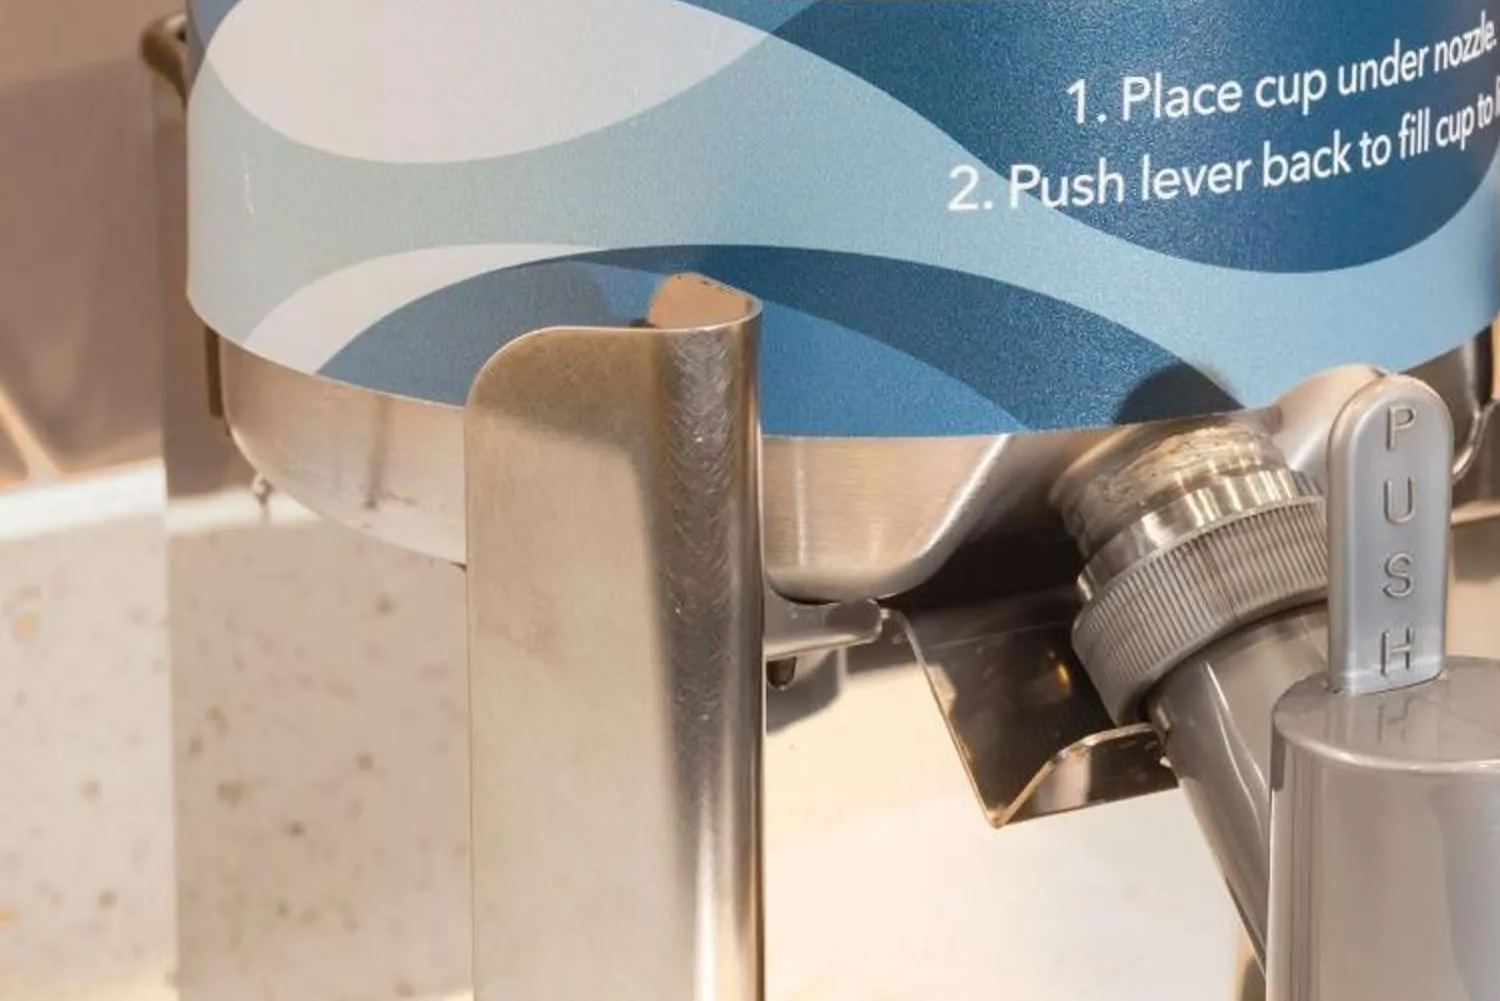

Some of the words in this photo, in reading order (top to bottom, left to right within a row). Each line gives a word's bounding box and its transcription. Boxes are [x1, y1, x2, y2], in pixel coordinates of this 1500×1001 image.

[1066, 78, 1107, 124] 1.
[1122, 72, 1242, 122] Place
[1254, 68, 1326, 116] cup
[1337, 38, 1429, 96] under
[1434, 9, 1497, 73] nozzle.
[947, 164, 993, 211] 2.
[1009, 157, 1125, 209] Push
[1141, 153, 1252, 201] lever
[1263, 129, 1352, 188] back
[1360, 130, 1392, 170] to
[1398, 107, 1431, 160] fill
[1435, 105, 1475, 151] cup
[1477, 93, 1494, 128] to
[1380, 405, 1417, 677] PUSH
